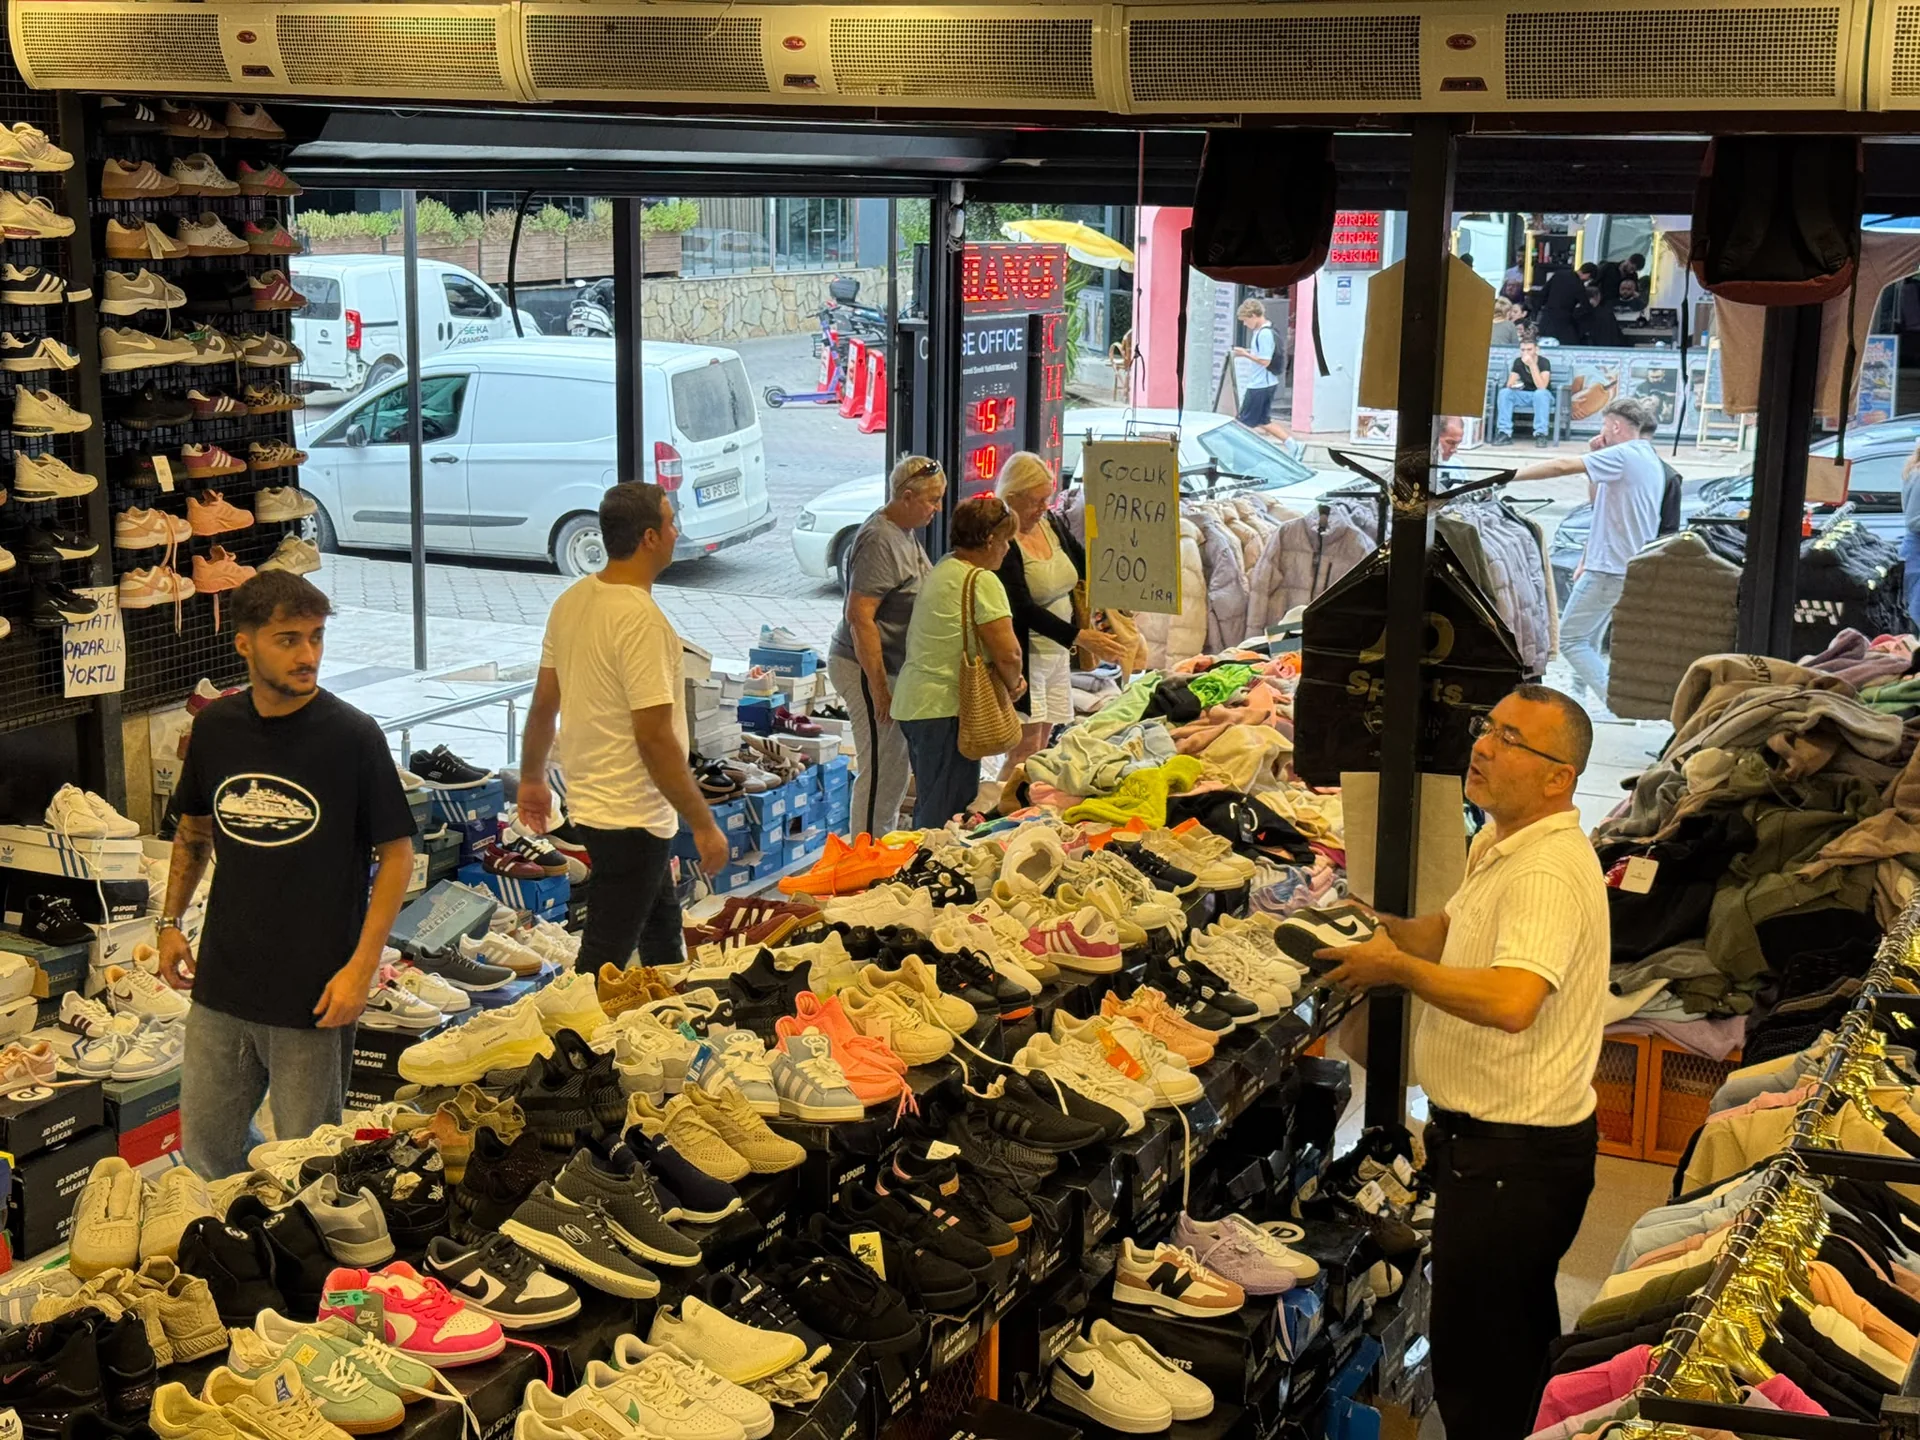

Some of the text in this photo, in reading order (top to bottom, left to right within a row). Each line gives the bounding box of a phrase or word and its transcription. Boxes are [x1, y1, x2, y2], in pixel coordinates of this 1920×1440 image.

[978, 328, 1023, 354] OFFICE
[976, 446, 996, 479] 40
[1100, 459, 1167, 486] ÇOCUK
[1103, 493, 1167, 523] PARÇA
[1099, 548, 1147, 583] 200
[66, 664, 116, 687] YOKTU
[355, 1059, 383, 1069] KALKAN
[361, 1050, 387, 1060] SPORTS
[356, 1092, 381, 1102] SPORTS
[41, 1116, 76, 1137] JD SPORTS
[45, 1129, 73, 1146] KALKAN
[56, 1166, 90, 1188] JD SPORTS
[60, 1179, 87, 1197] KALKAN
